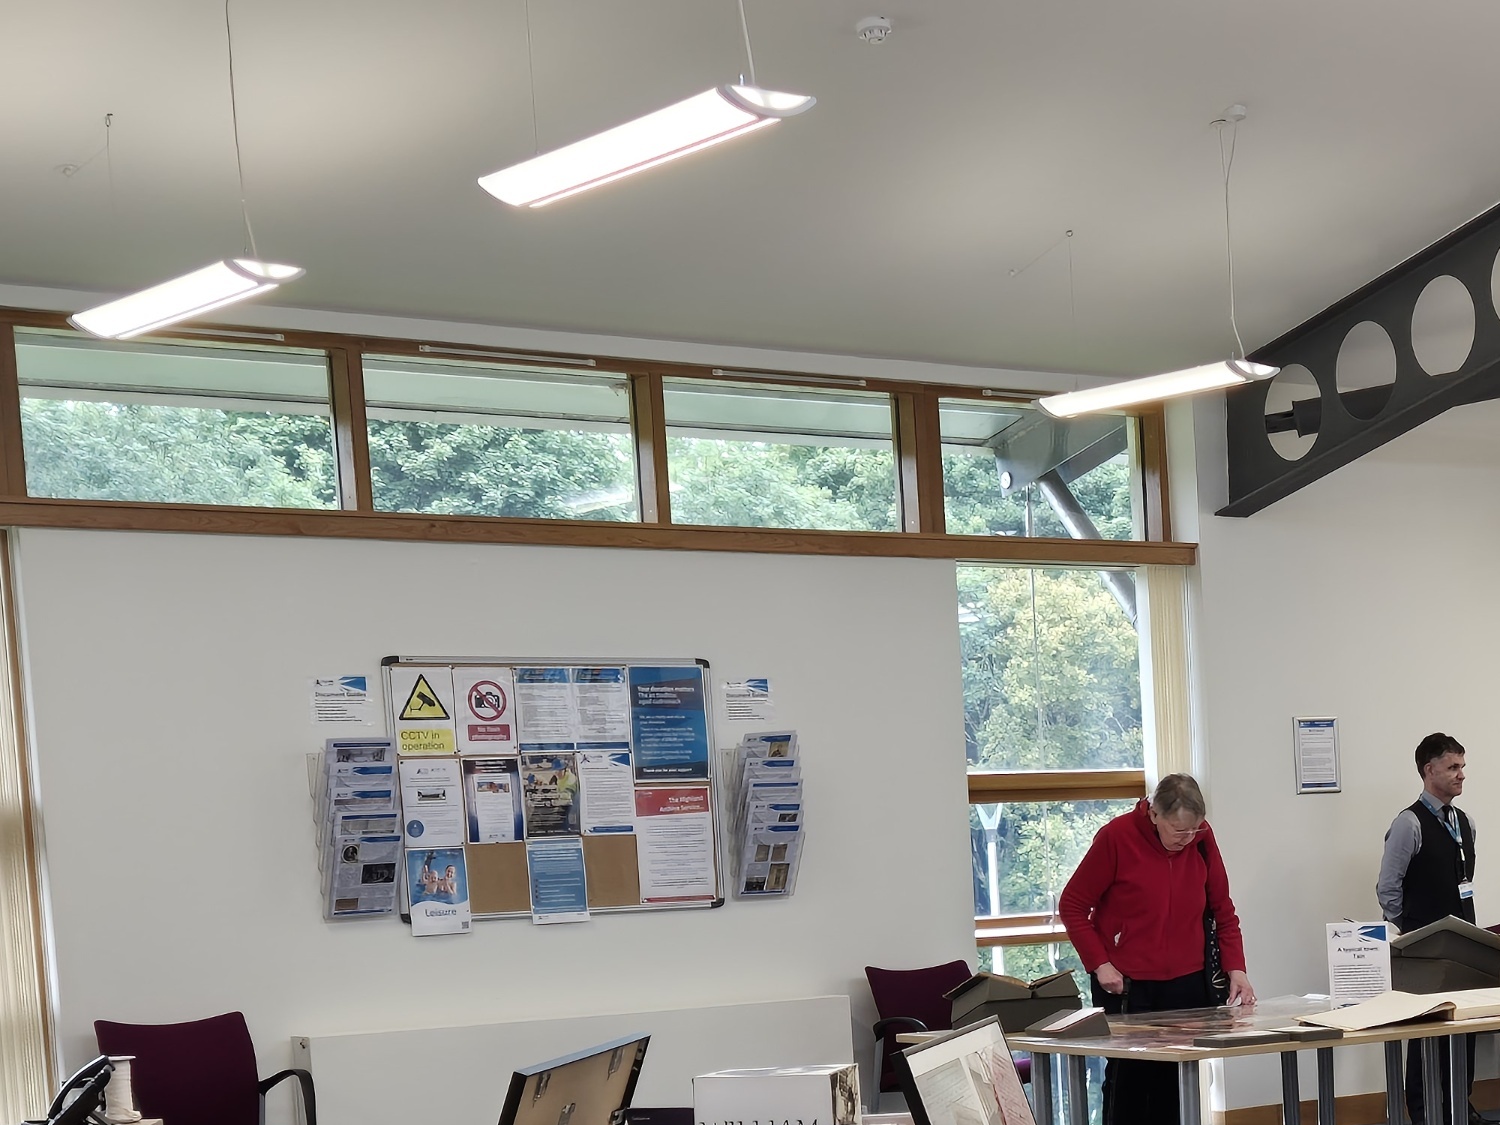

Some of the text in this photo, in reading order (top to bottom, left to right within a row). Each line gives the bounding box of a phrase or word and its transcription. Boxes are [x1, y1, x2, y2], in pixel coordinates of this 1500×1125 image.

[400, 730, 440, 740] CCTV in
[401, 741, 445, 753] operation
[679, 795, 704, 804] Highland
[424, 908, 457, 918] Leisure
